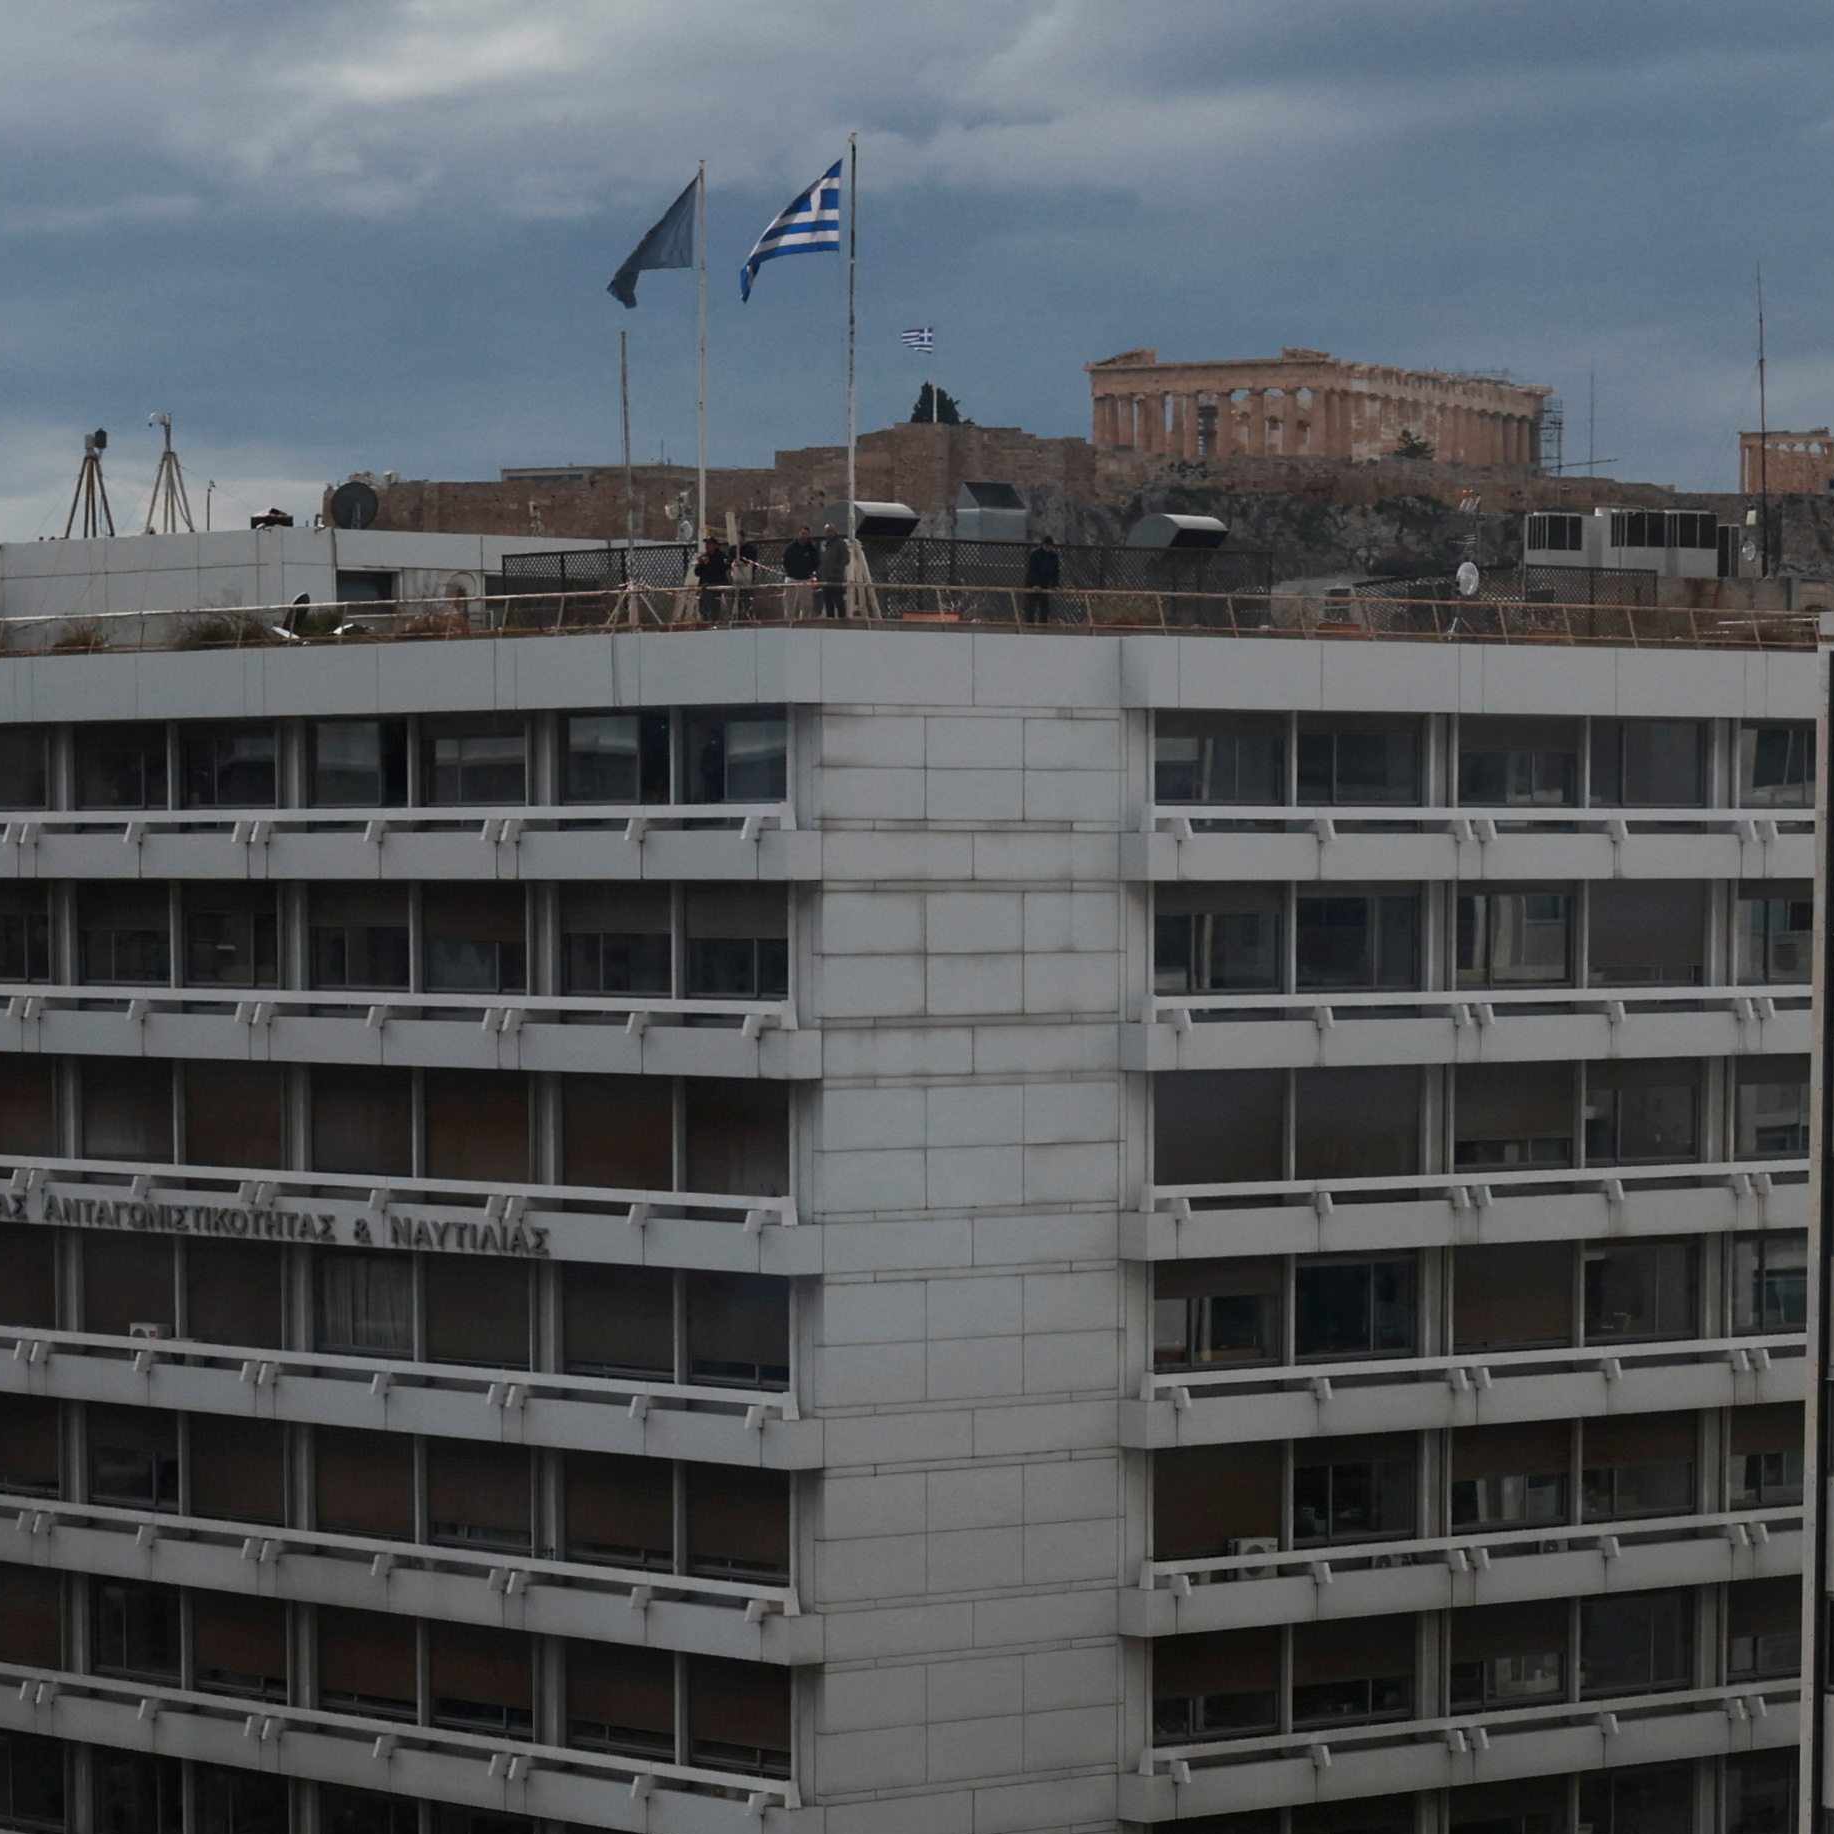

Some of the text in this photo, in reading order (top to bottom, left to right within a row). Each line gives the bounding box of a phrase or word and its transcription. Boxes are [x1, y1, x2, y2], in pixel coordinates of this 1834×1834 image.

[43, 1193, 336, 1243] ΑΝΤΑΓΩΝΙΣΤΙΚΟΤΗΤΑΣ
[353, 1218, 372, 1245] &
[390, 1216, 550, 1256] ΝΑΥΤΙΛΙΑΣ
